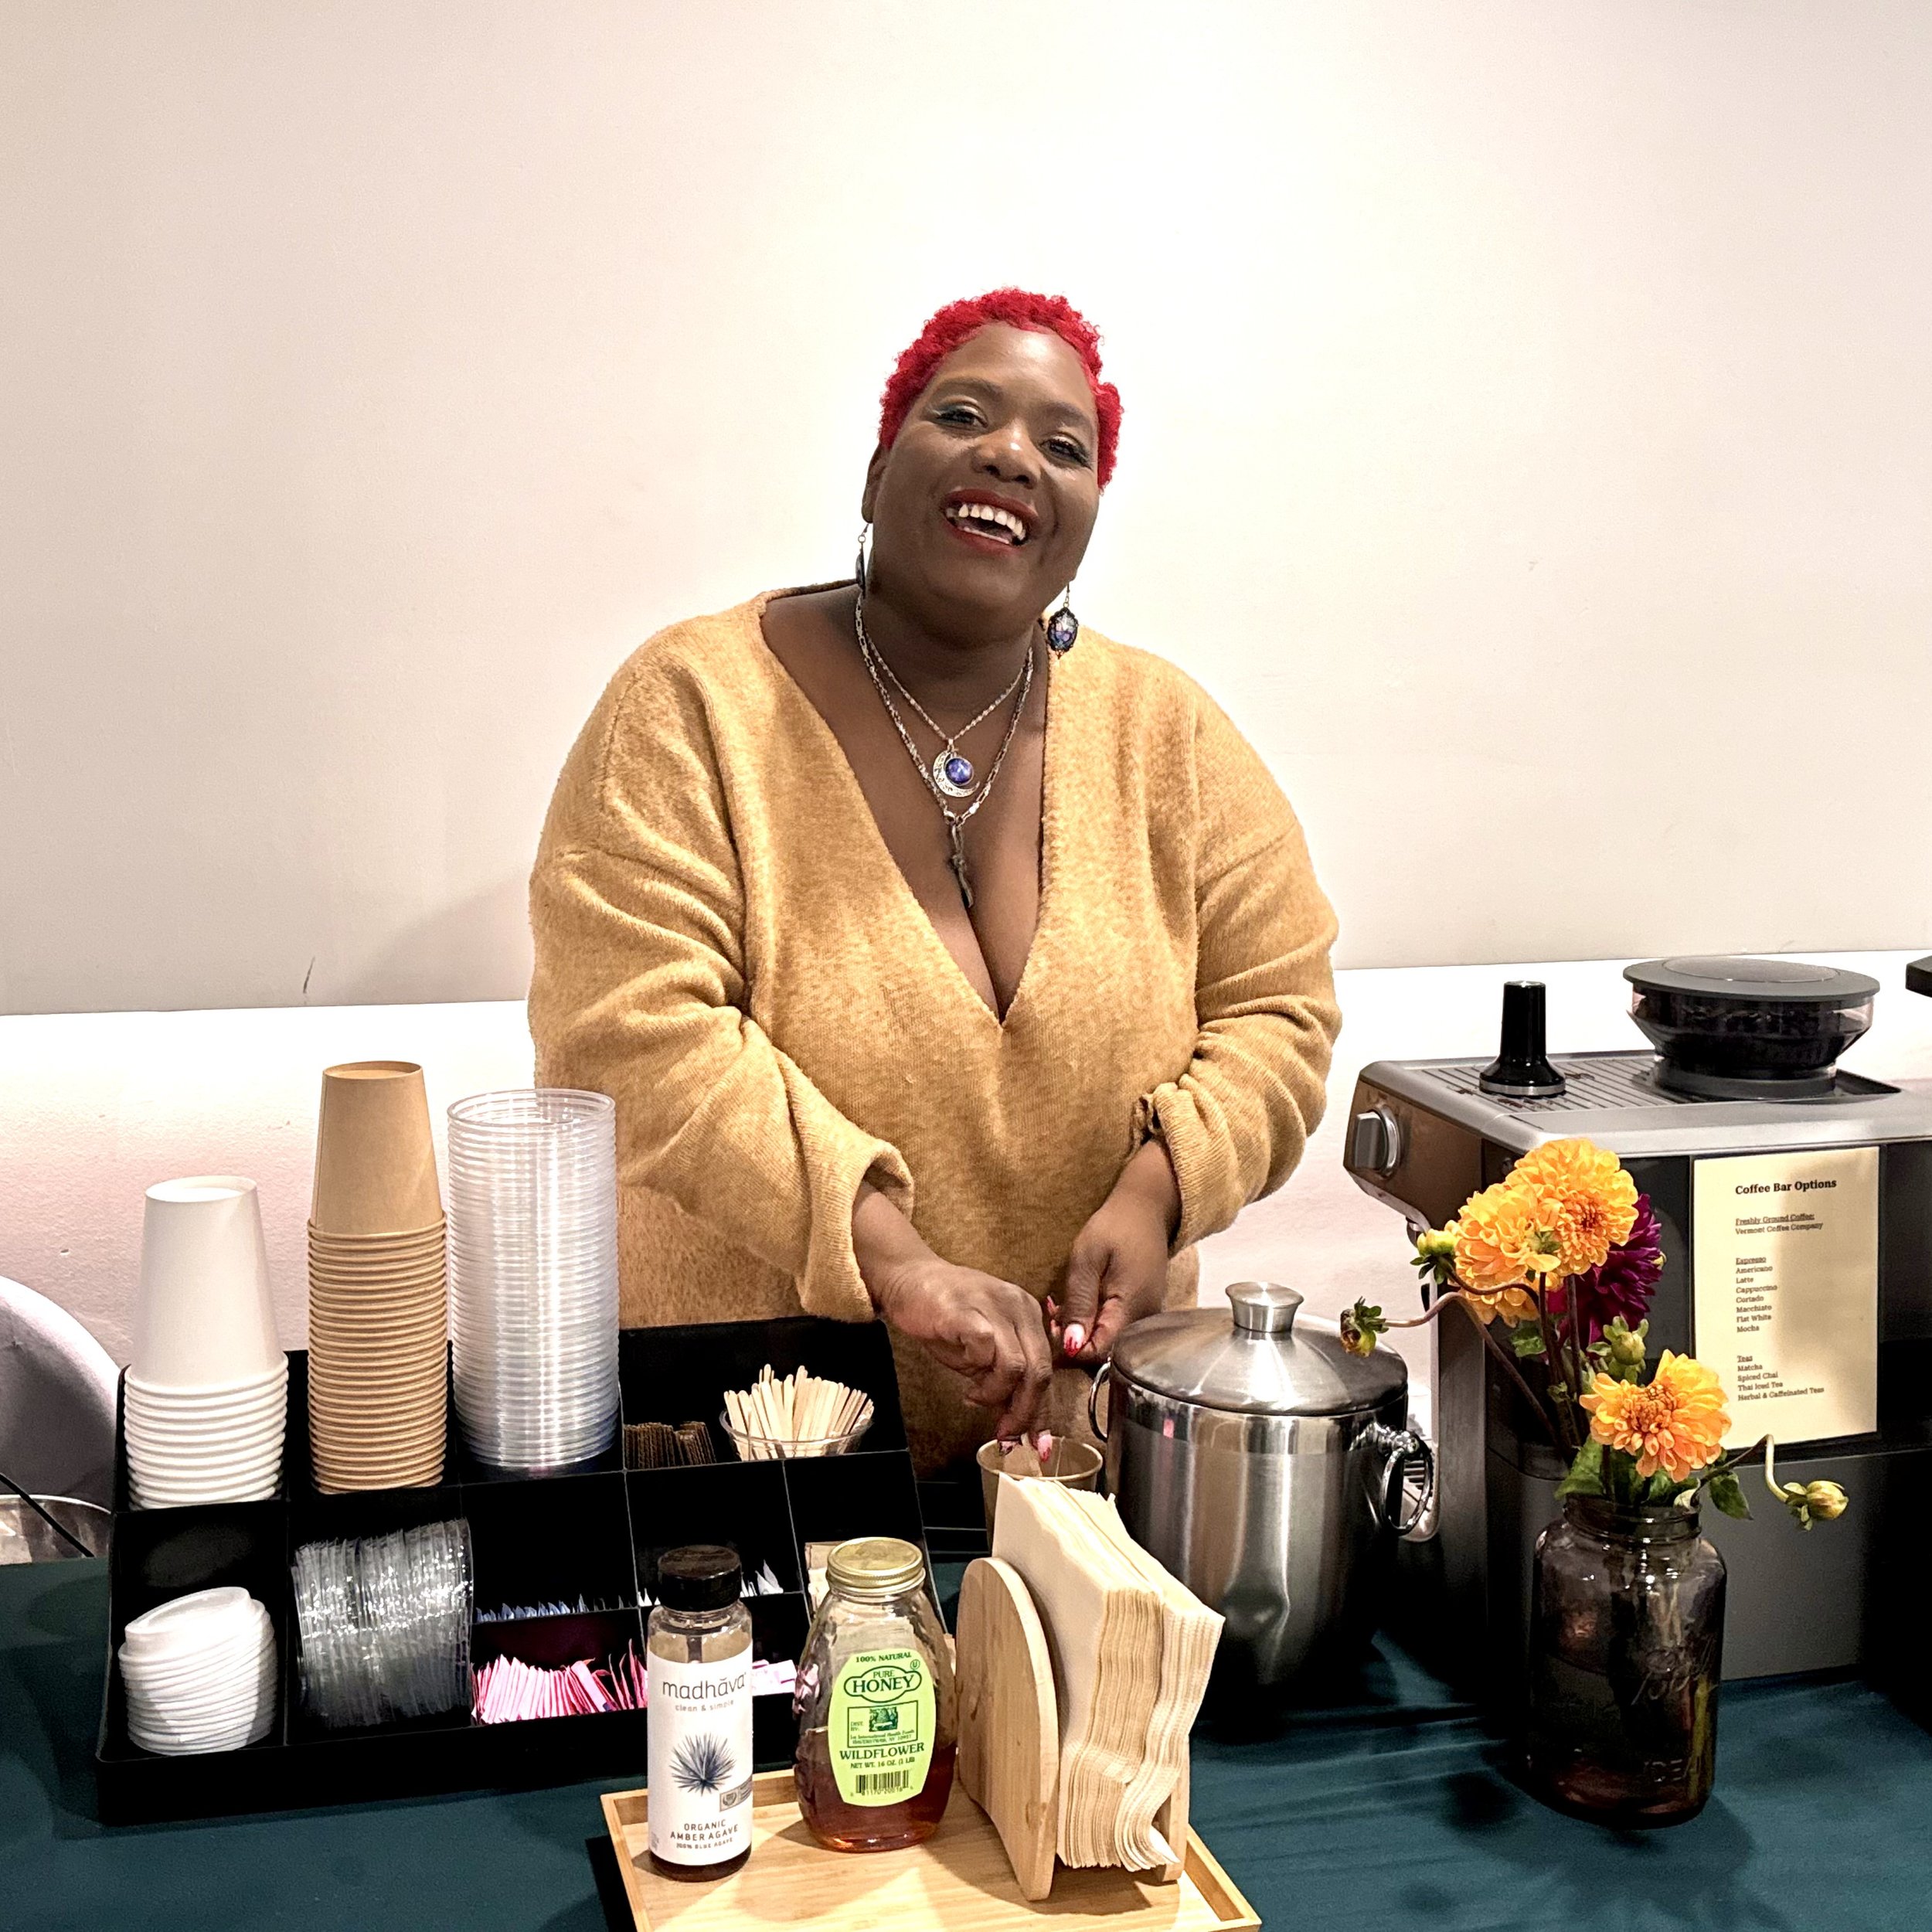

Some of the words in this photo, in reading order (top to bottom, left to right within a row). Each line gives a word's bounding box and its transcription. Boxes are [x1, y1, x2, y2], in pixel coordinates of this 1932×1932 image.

[1735, 1184, 1770, 1195] Coffee
[1774, 1182, 1792, 1192] Bar
[1794, 1179, 1837, 1193] Options
[1736, 1216, 1761, 1226] Freshly
[1763, 1215, 1789, 1223] Ground
[1735, 1226, 1765, 1235] Vermont
[1791, 1223, 1824, 1231] Company
[1736, 1257, 1767, 1265] Espresso
[1736, 1266, 1774, 1274] Americano
[1736, 1284, 1778, 1294] Cappuccino
[1736, 1294, 1764, 1304] Cortado
[1736, 1304, 1772, 1313] Macchiato
[1736, 1325, 1760, 1333] Mocha
[1737, 1373, 1761, 1383] Spiced
[1763, 1371, 1778, 1379] Chai
[1769, 1388, 1808, 1398] Caffeinated
[879, 1651, 912, 1662] NATURAL
[872, 1669, 895, 1678] PURE
[852, 1674, 915, 1693] HONEY
[675, 1703, 698, 1712] clean
[709, 1699, 734, 1711] simple
[839, 1742, 925, 1760] WILDFLOWER
[684, 1818, 726, 1832] ORGANIC
[670, 1831, 705, 1842] AMBER
[709, 1824, 739, 1841] AGAVE
[714, 1837, 733, 1848] AGAVE
